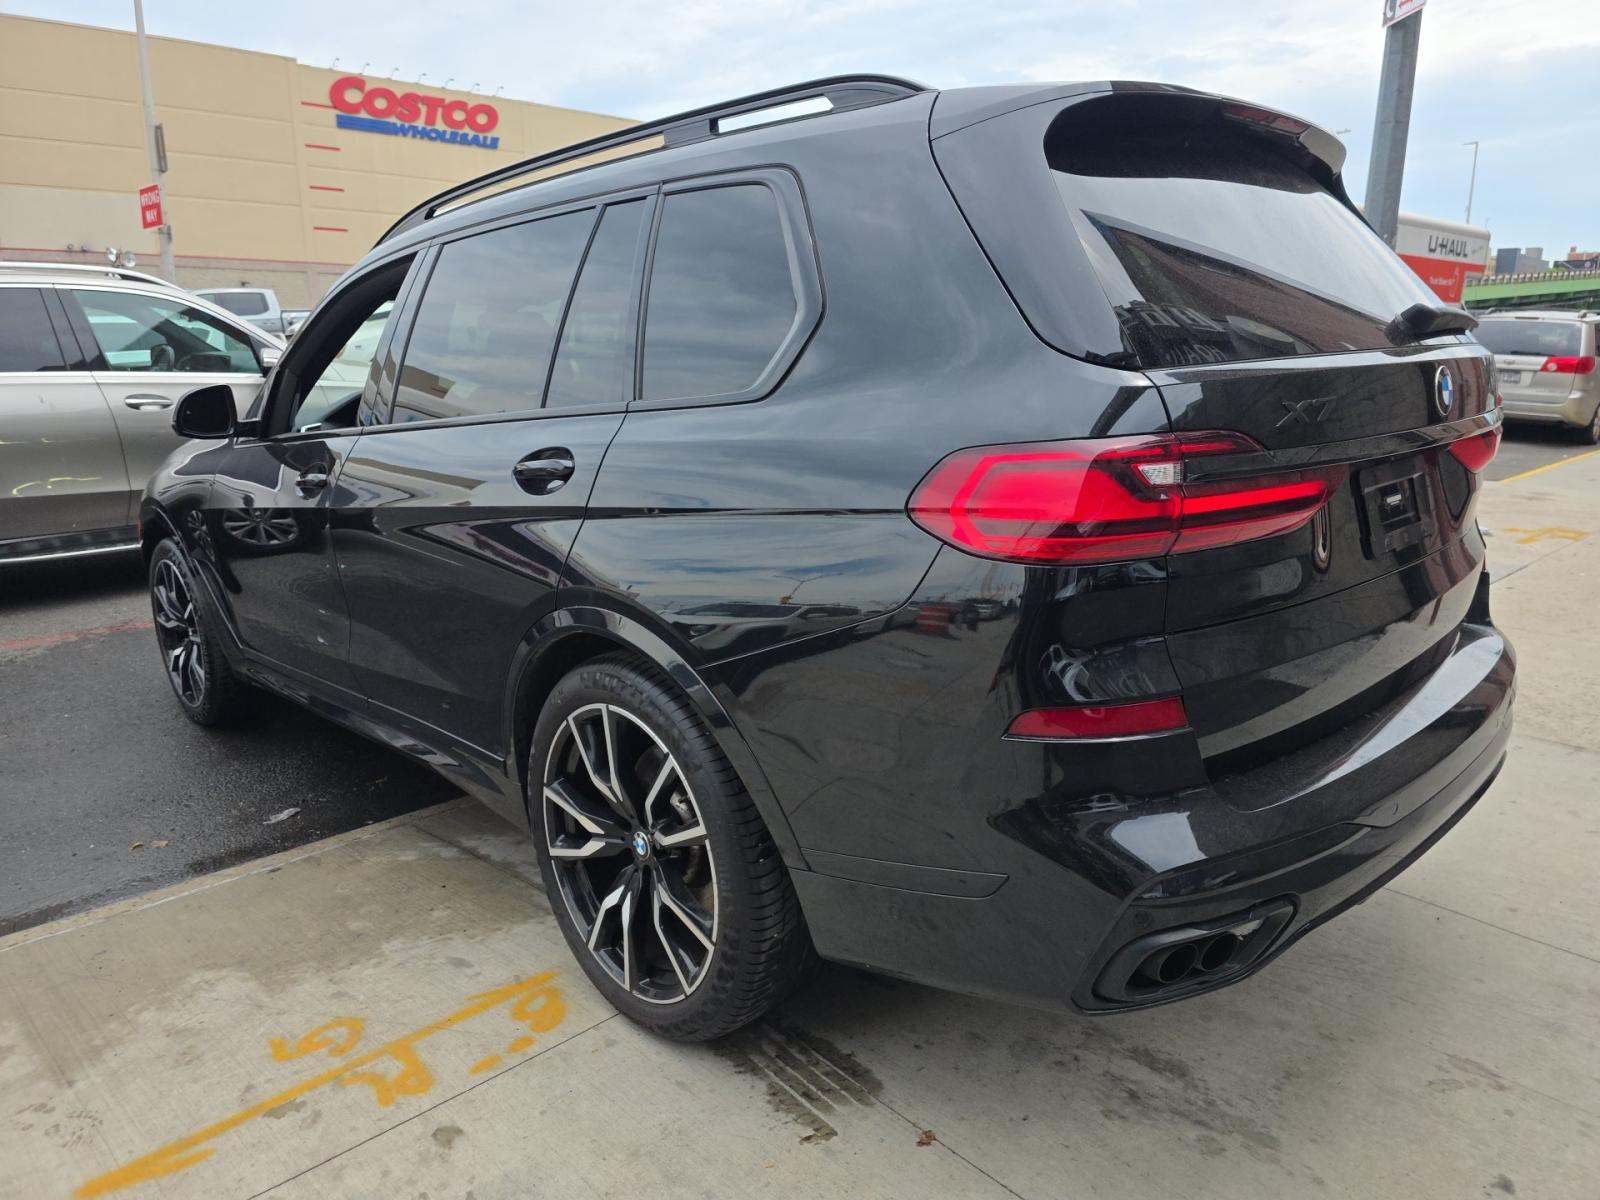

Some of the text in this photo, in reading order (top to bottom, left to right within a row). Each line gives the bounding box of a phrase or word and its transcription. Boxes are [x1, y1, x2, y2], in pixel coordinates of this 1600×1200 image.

[329, 75, 499, 134] COSTCO
[391, 121, 500, 150] WHOLESALE
[140, 189, 160, 207] WRONG
[145, 208, 158, 223] WAY
[1427, 234, 1469, 258] U-HAUL
[1274, 395, 1338, 428] X7
